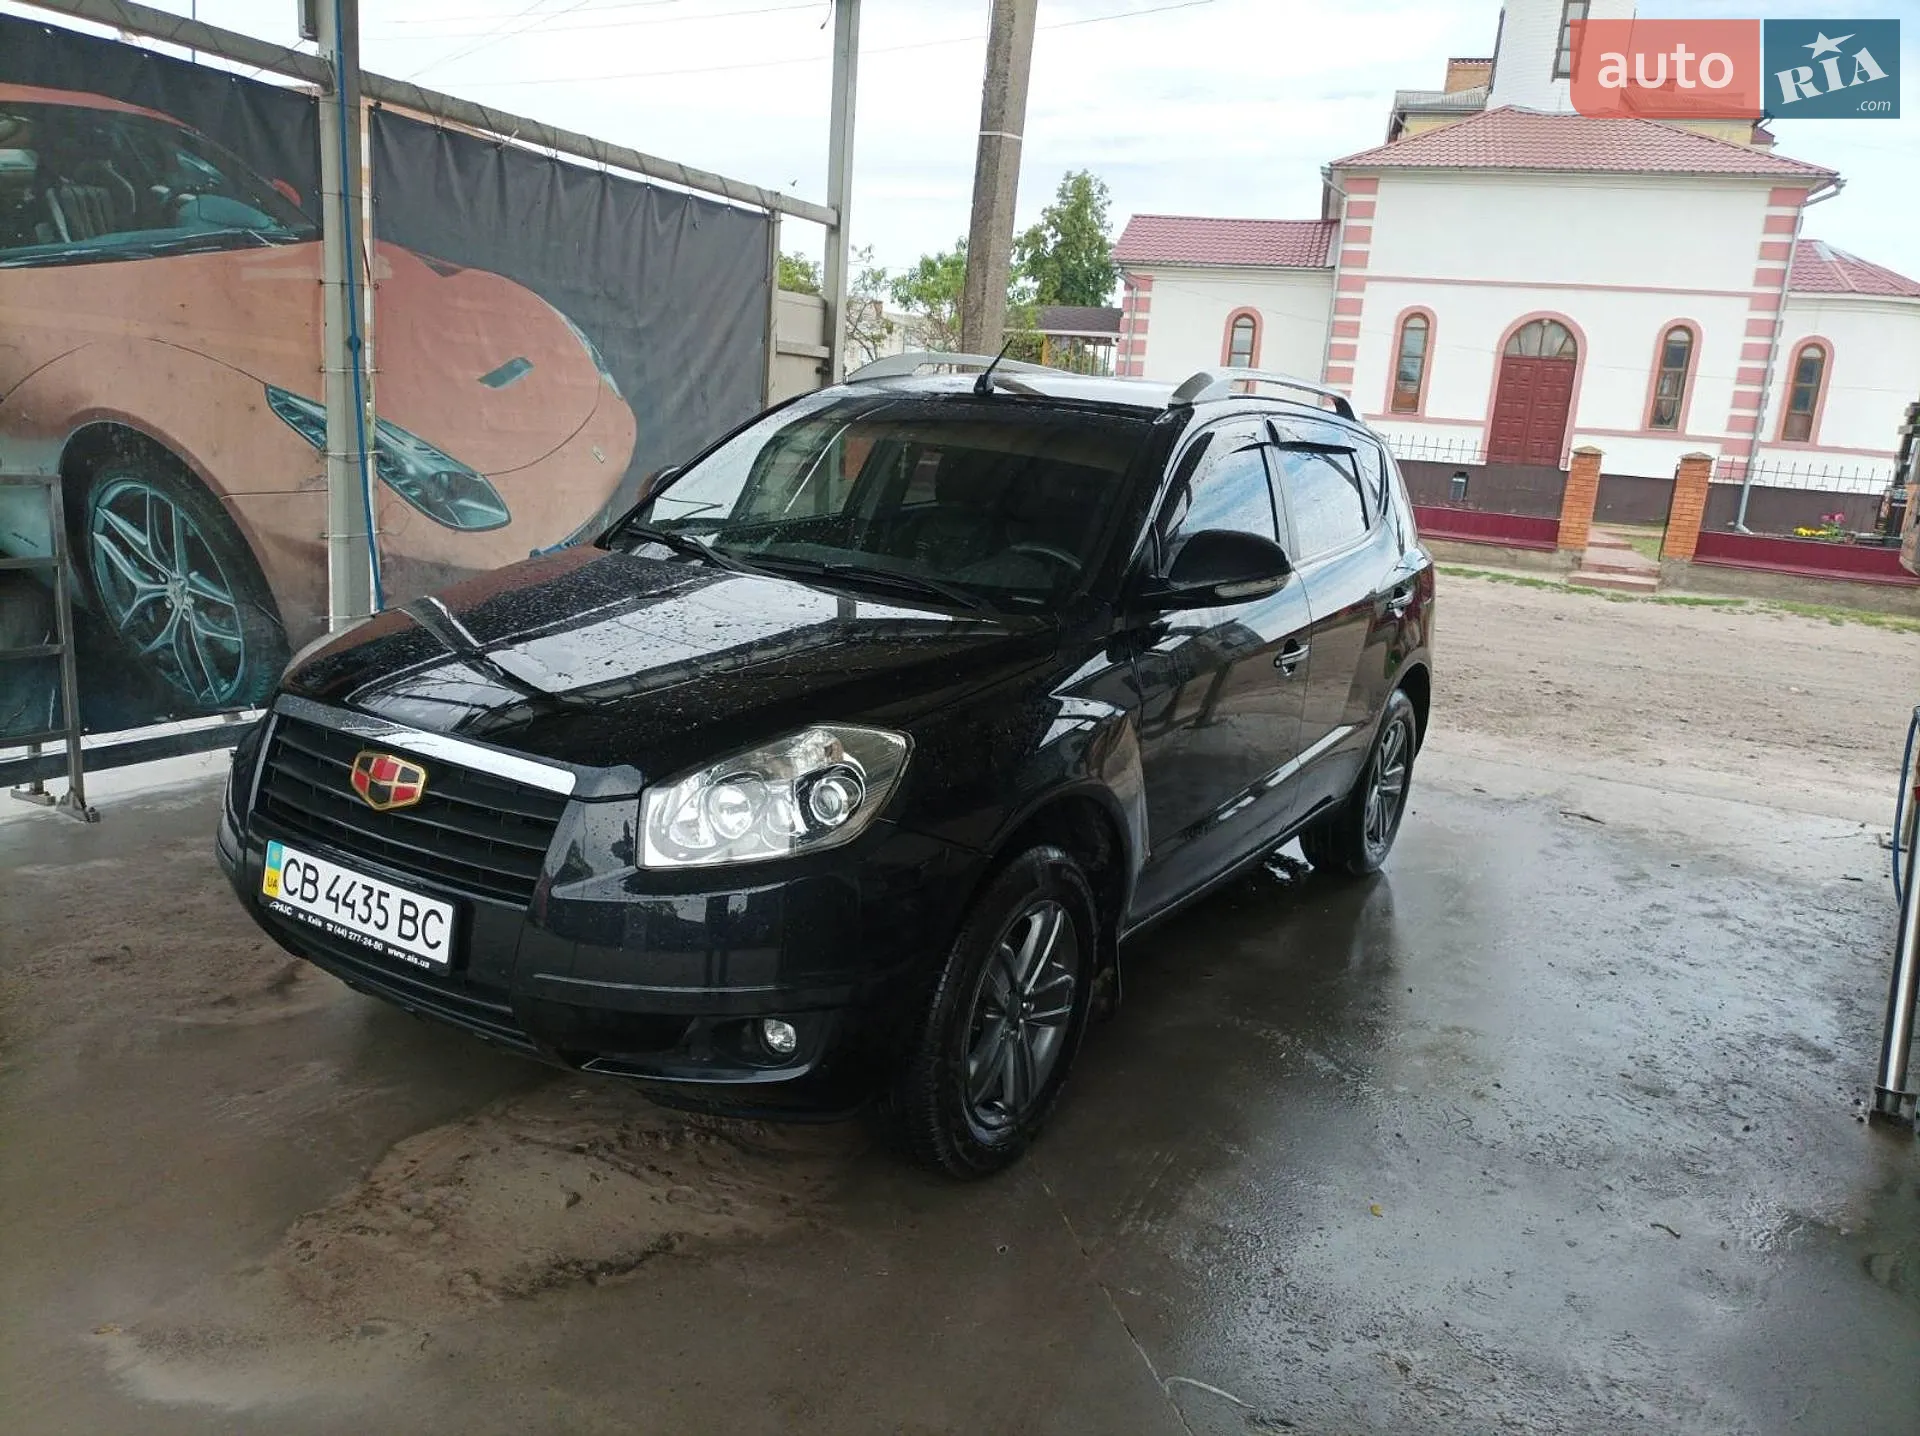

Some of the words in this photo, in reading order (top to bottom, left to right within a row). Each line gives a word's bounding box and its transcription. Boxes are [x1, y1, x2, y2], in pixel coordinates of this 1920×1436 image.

[267, 876, 279, 888] UA
[283, 857, 319, 904] CB
[325, 874, 390, 931] 4435
[397, 898, 444, 950] BC
[333, 925, 347, 939] (44)
[387, 947, 430, 969] www.ais.ua
